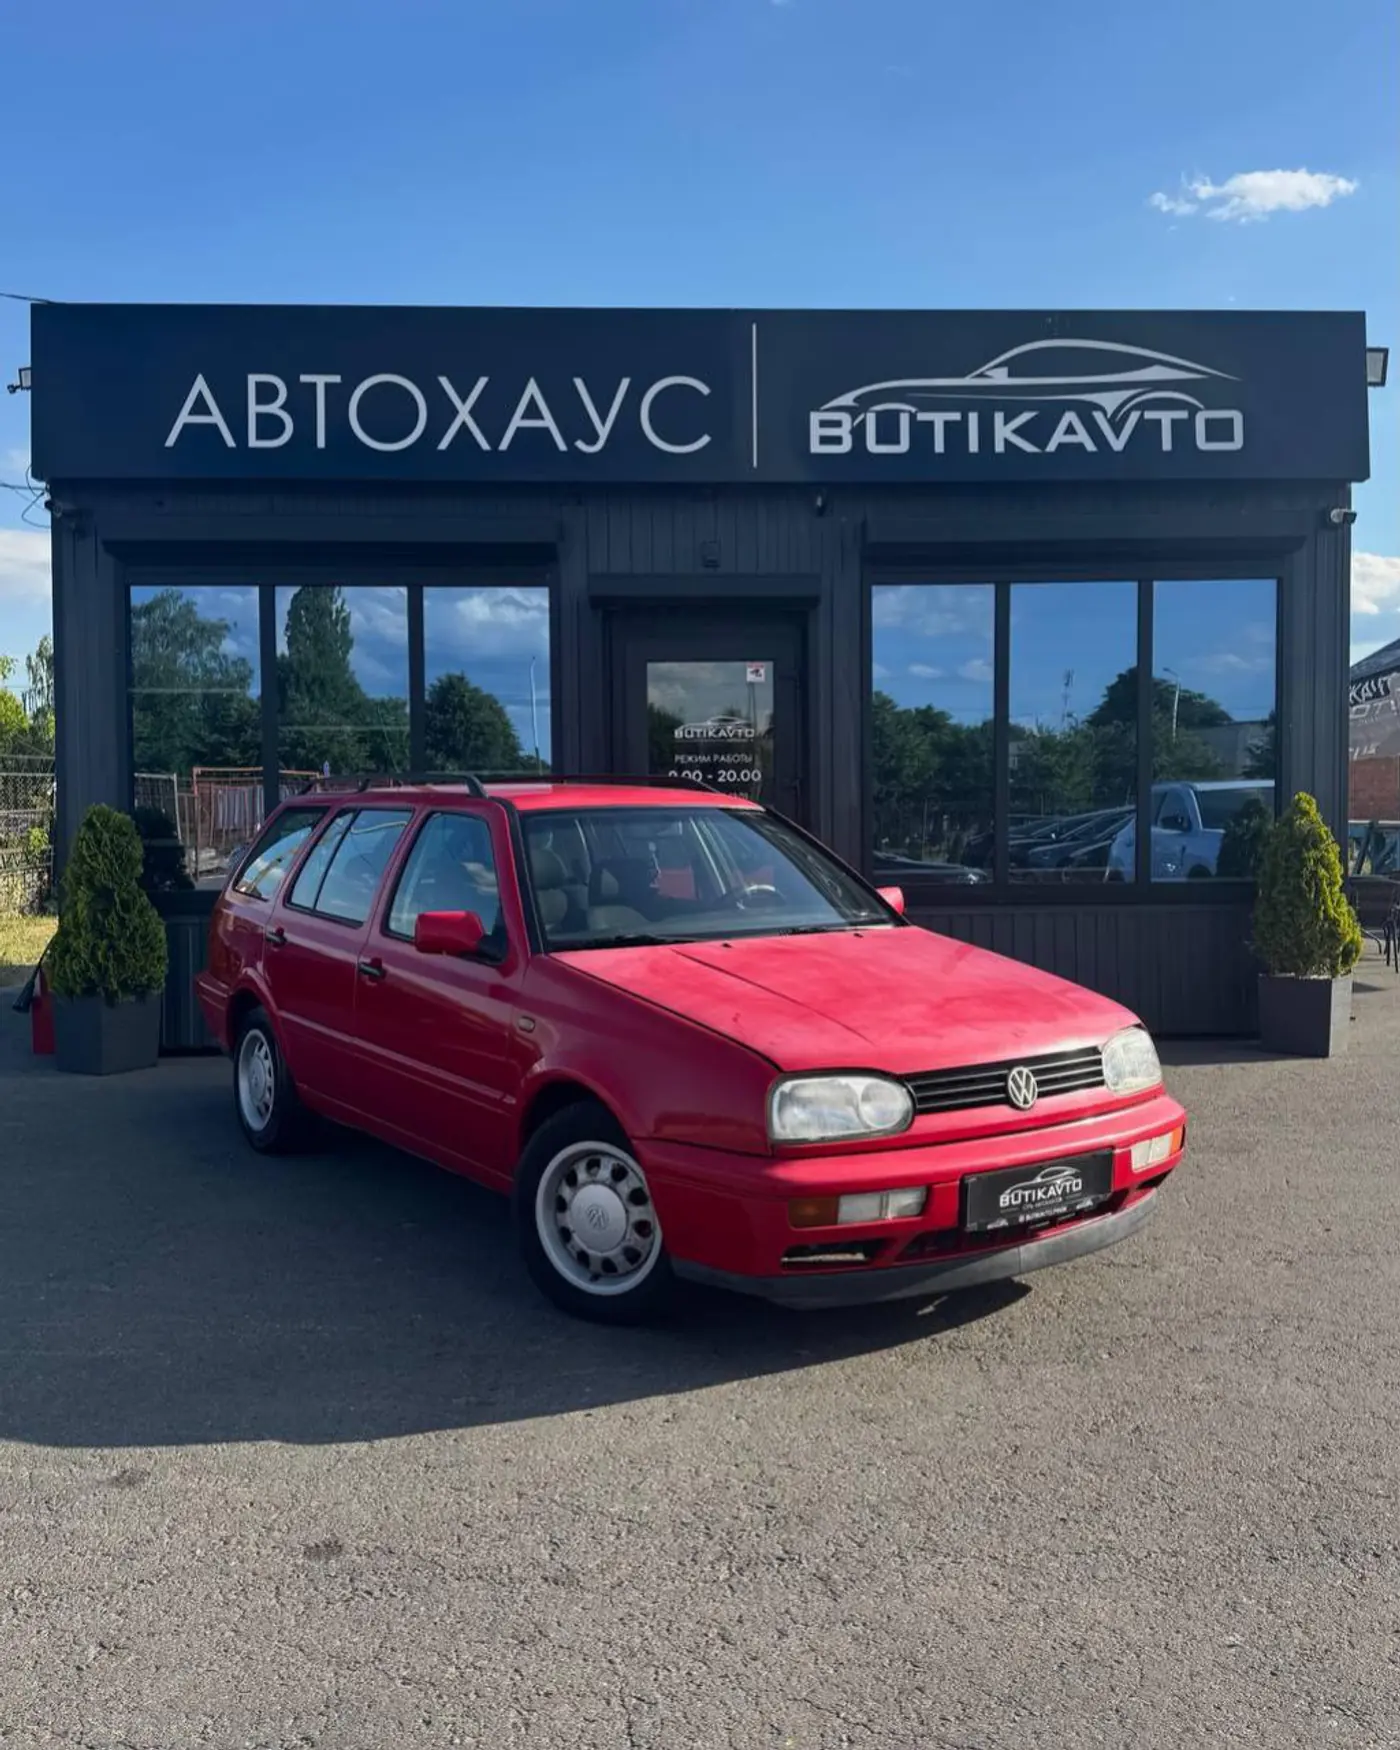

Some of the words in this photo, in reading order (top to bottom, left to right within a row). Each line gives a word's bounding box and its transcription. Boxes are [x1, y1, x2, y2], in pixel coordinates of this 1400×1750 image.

[164, 373, 711, 454] АВТОХАУС
[809, 410, 1244, 454] BUTIKAVTO
[674, 728, 755, 739] BUTIKAVTO
[674, 754, 711, 763] РЕЖИМ
[713, 753, 753, 763] РАБОТЫ
[717, 769, 762, 782] 20.00
[999, 1178, 1083, 1208] BUTIKAVTO
